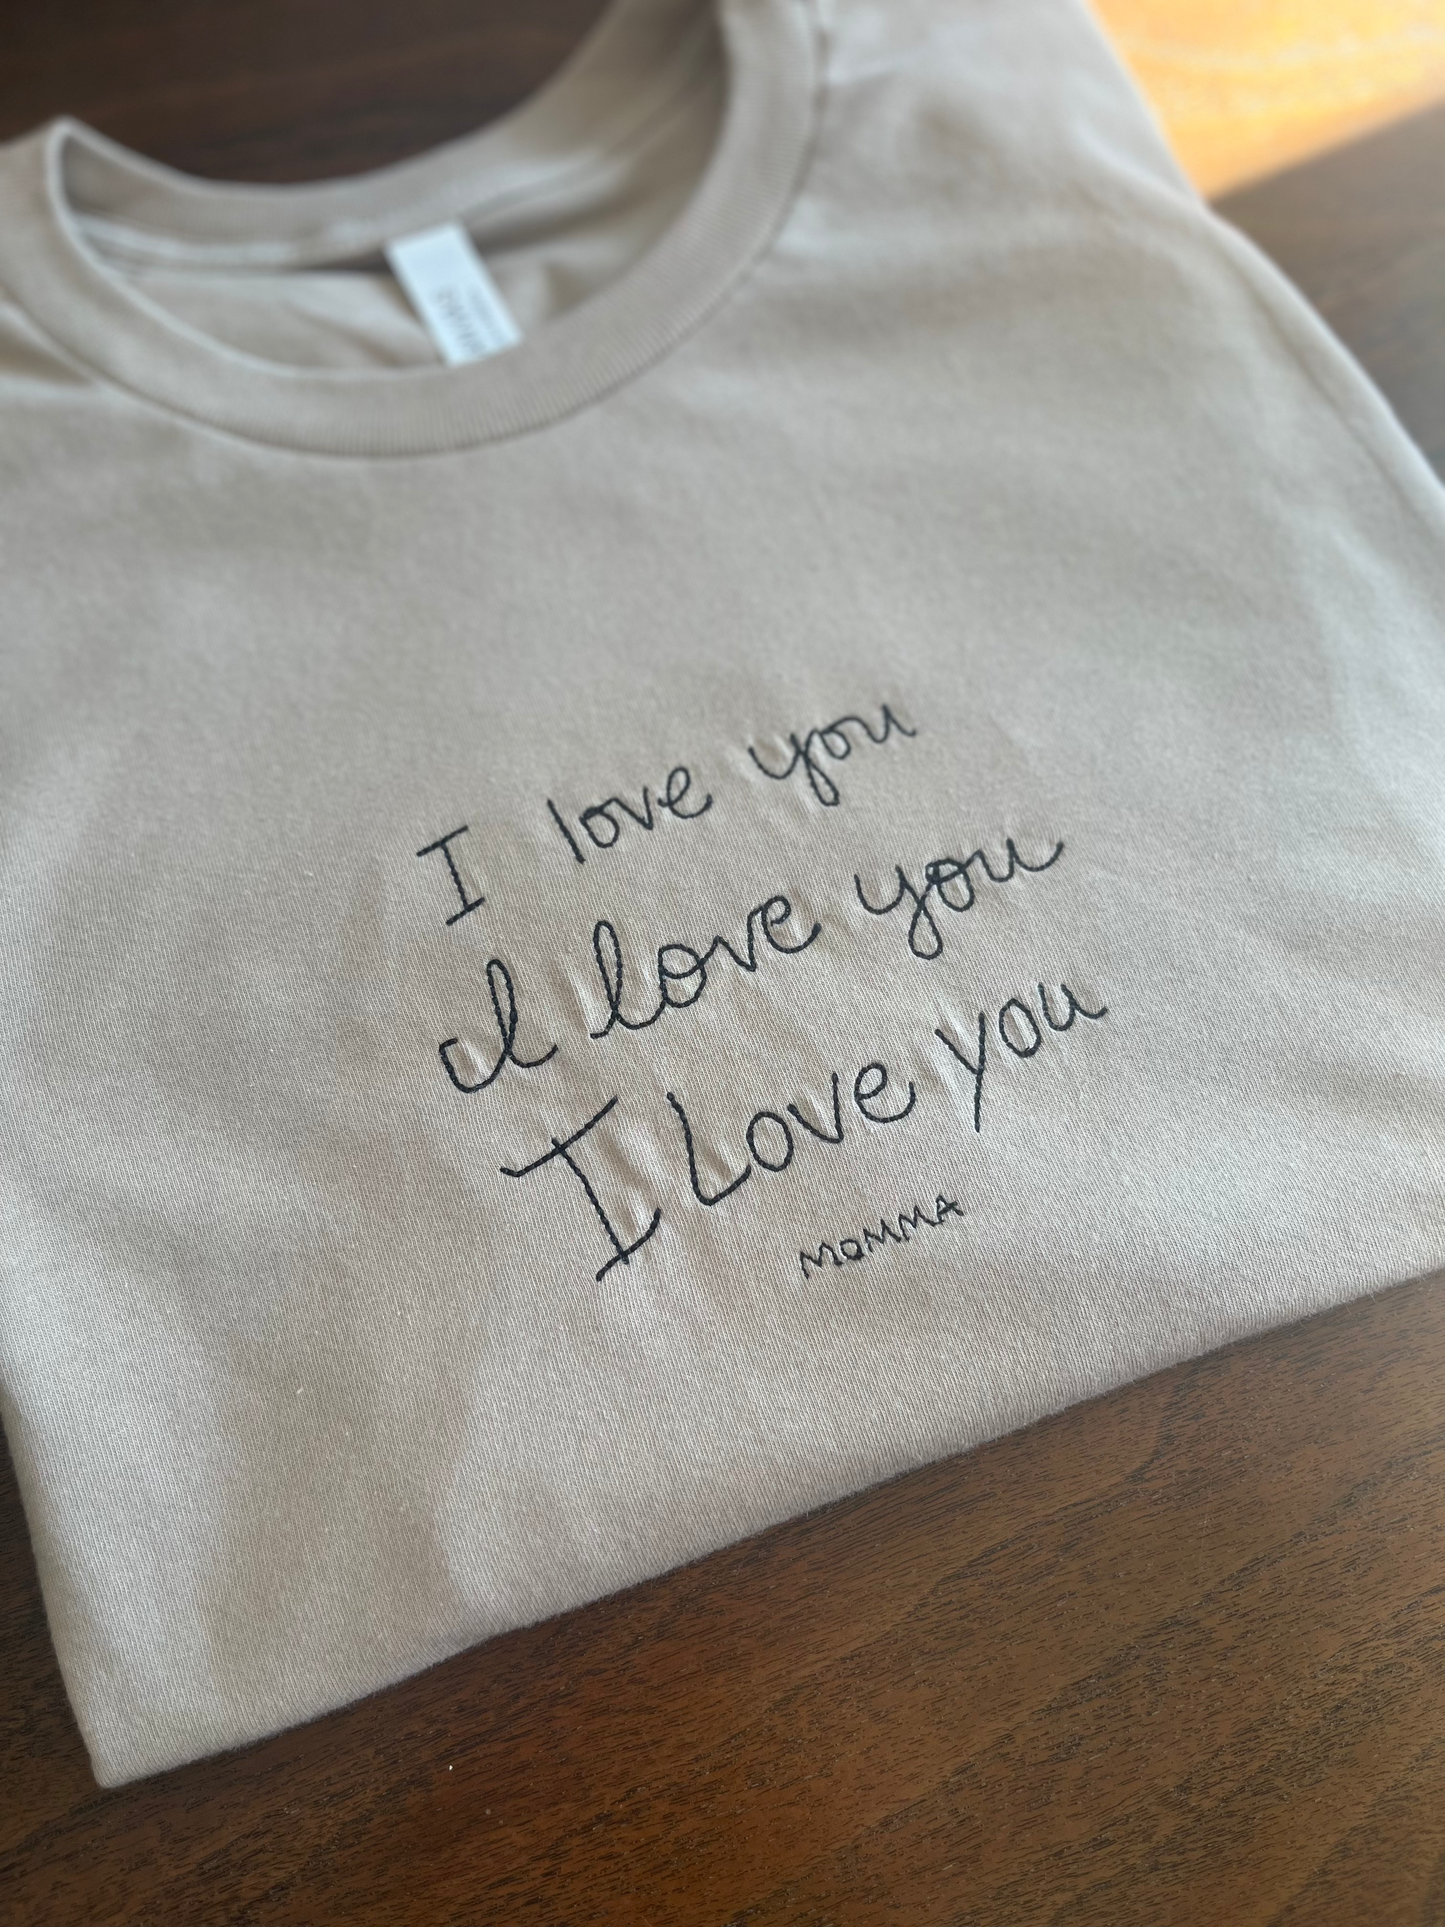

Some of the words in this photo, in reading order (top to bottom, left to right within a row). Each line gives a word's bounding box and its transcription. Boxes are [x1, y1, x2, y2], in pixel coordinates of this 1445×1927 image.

[415, 824, 487, 927] I
[546, 766, 714, 866] love
[747, 703, 918, 807] you
[438, 957, 560, 1094] I
[590, 894, 823, 1040] love
[853, 836, 1066, 961] you
[500, 1097, 662, 1283] I
[665, 1060, 917, 1208] Love
[799, 1194, 966, 1279] MOMMA
